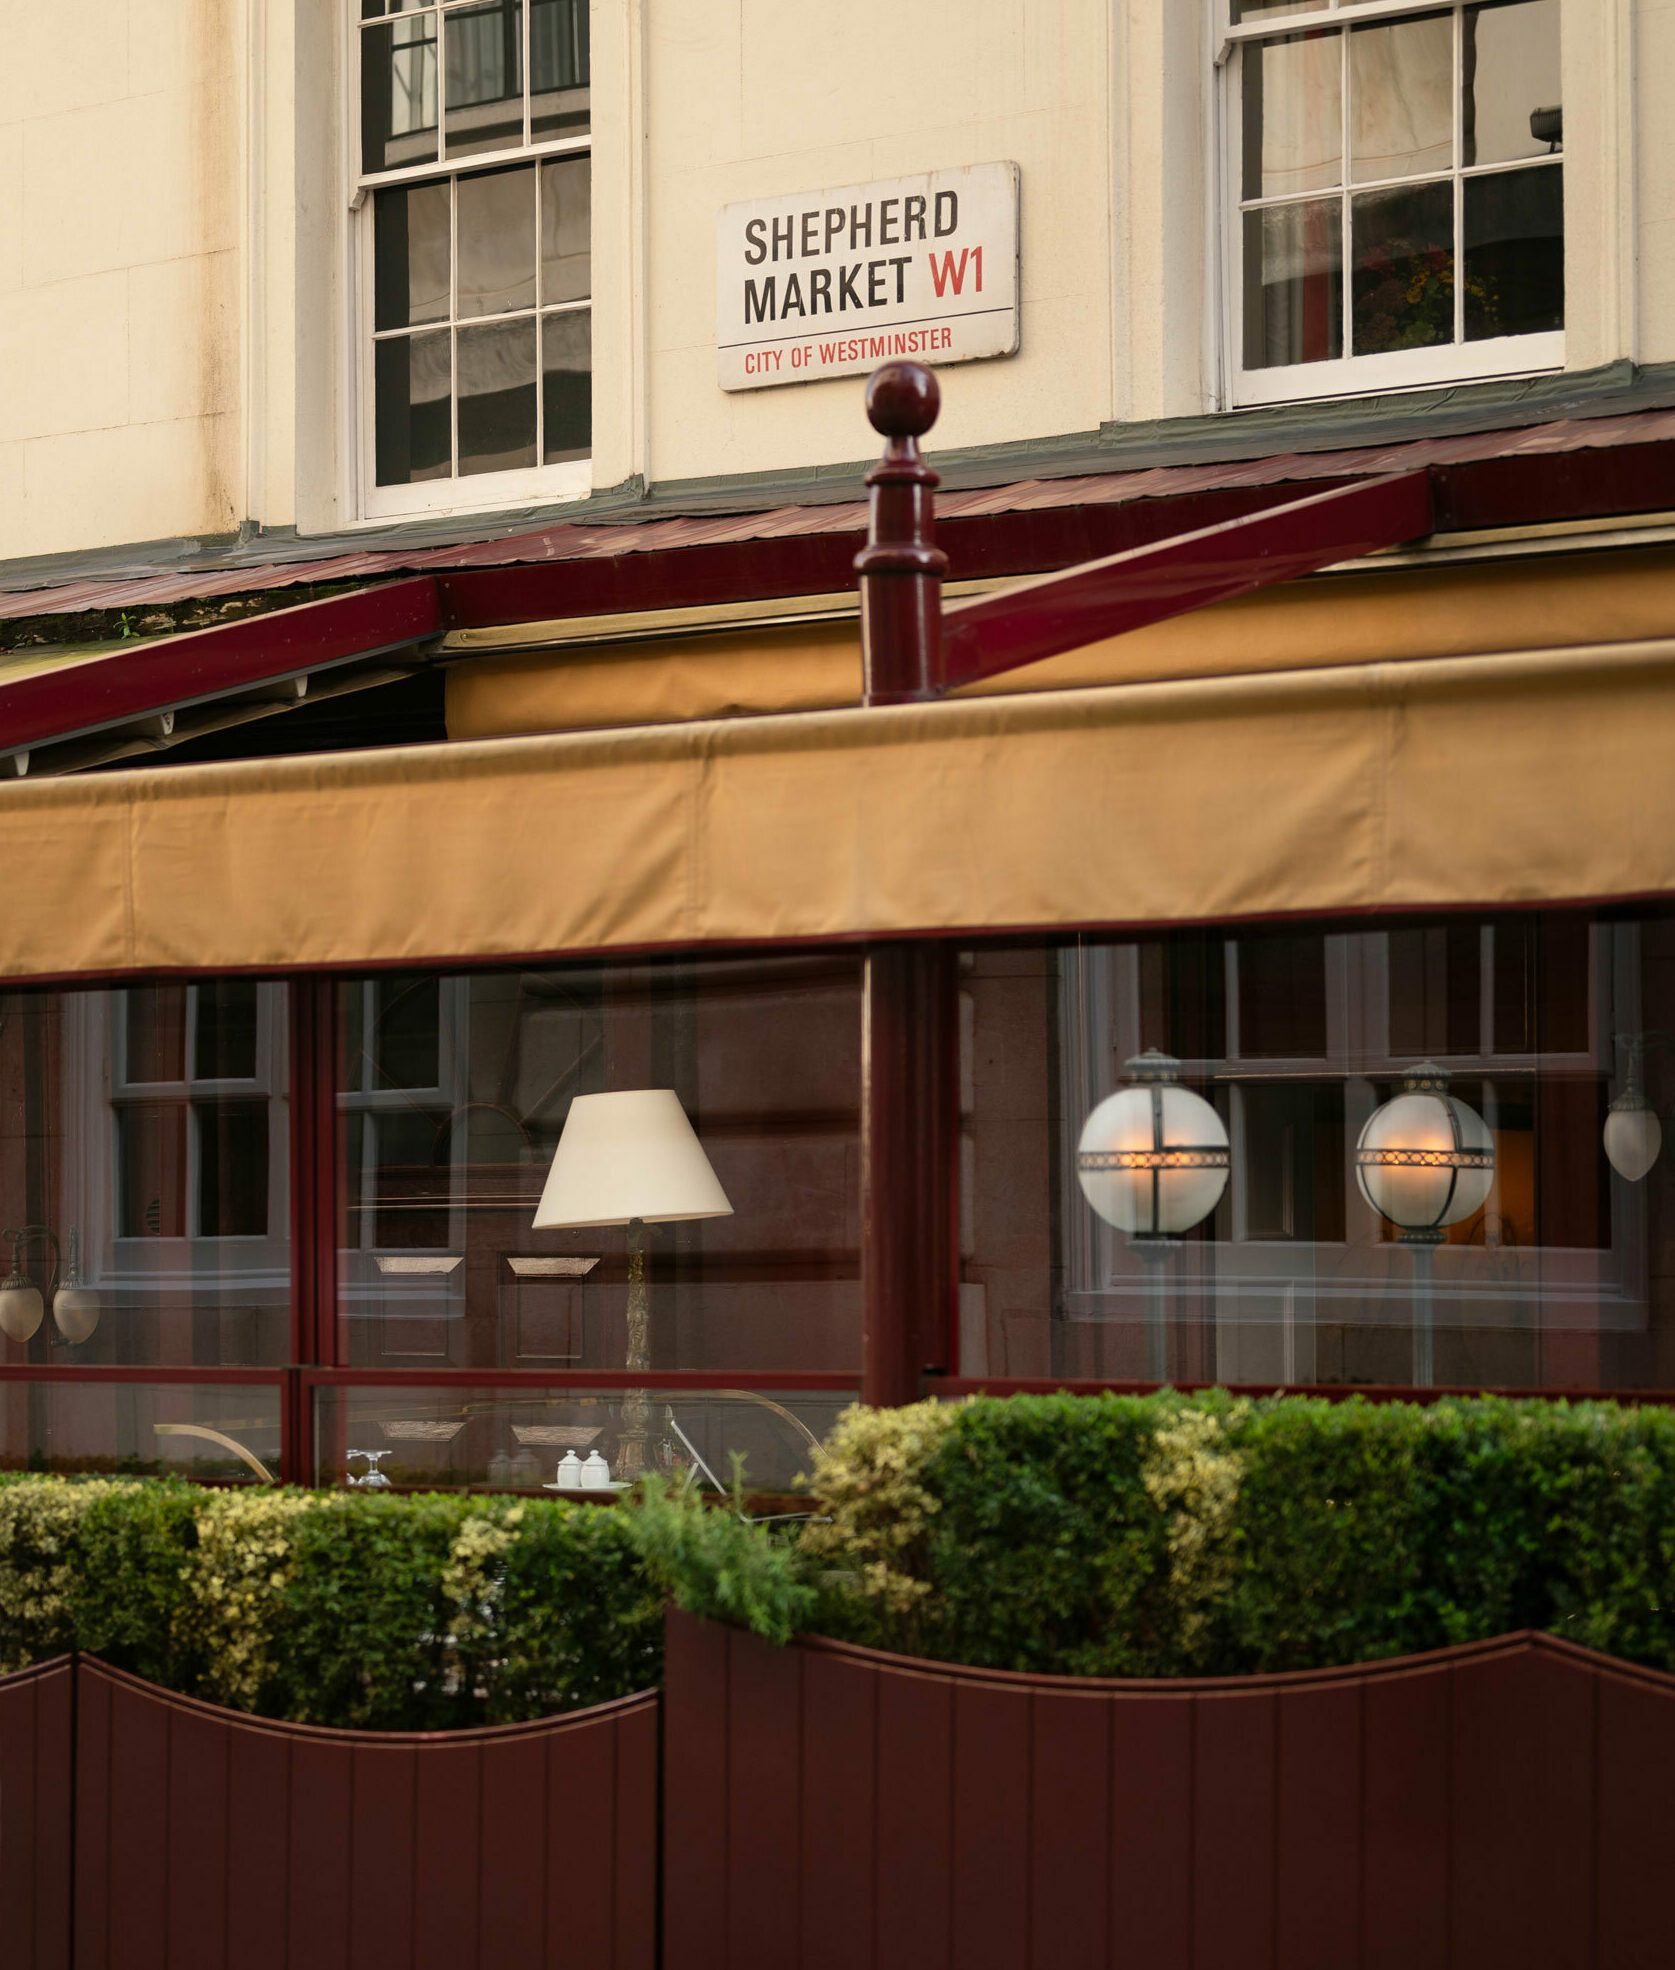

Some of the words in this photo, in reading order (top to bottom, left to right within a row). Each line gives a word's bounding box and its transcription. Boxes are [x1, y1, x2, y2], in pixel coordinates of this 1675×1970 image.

[744, 190, 959, 266] SHEPHERD
[744, 256, 913, 325] MARKET
[928, 245, 983, 298] W1
[745, 349, 783, 375] CITY
[791, 345, 813, 369] OF
[819, 326, 952, 365] WESTMINSTER
